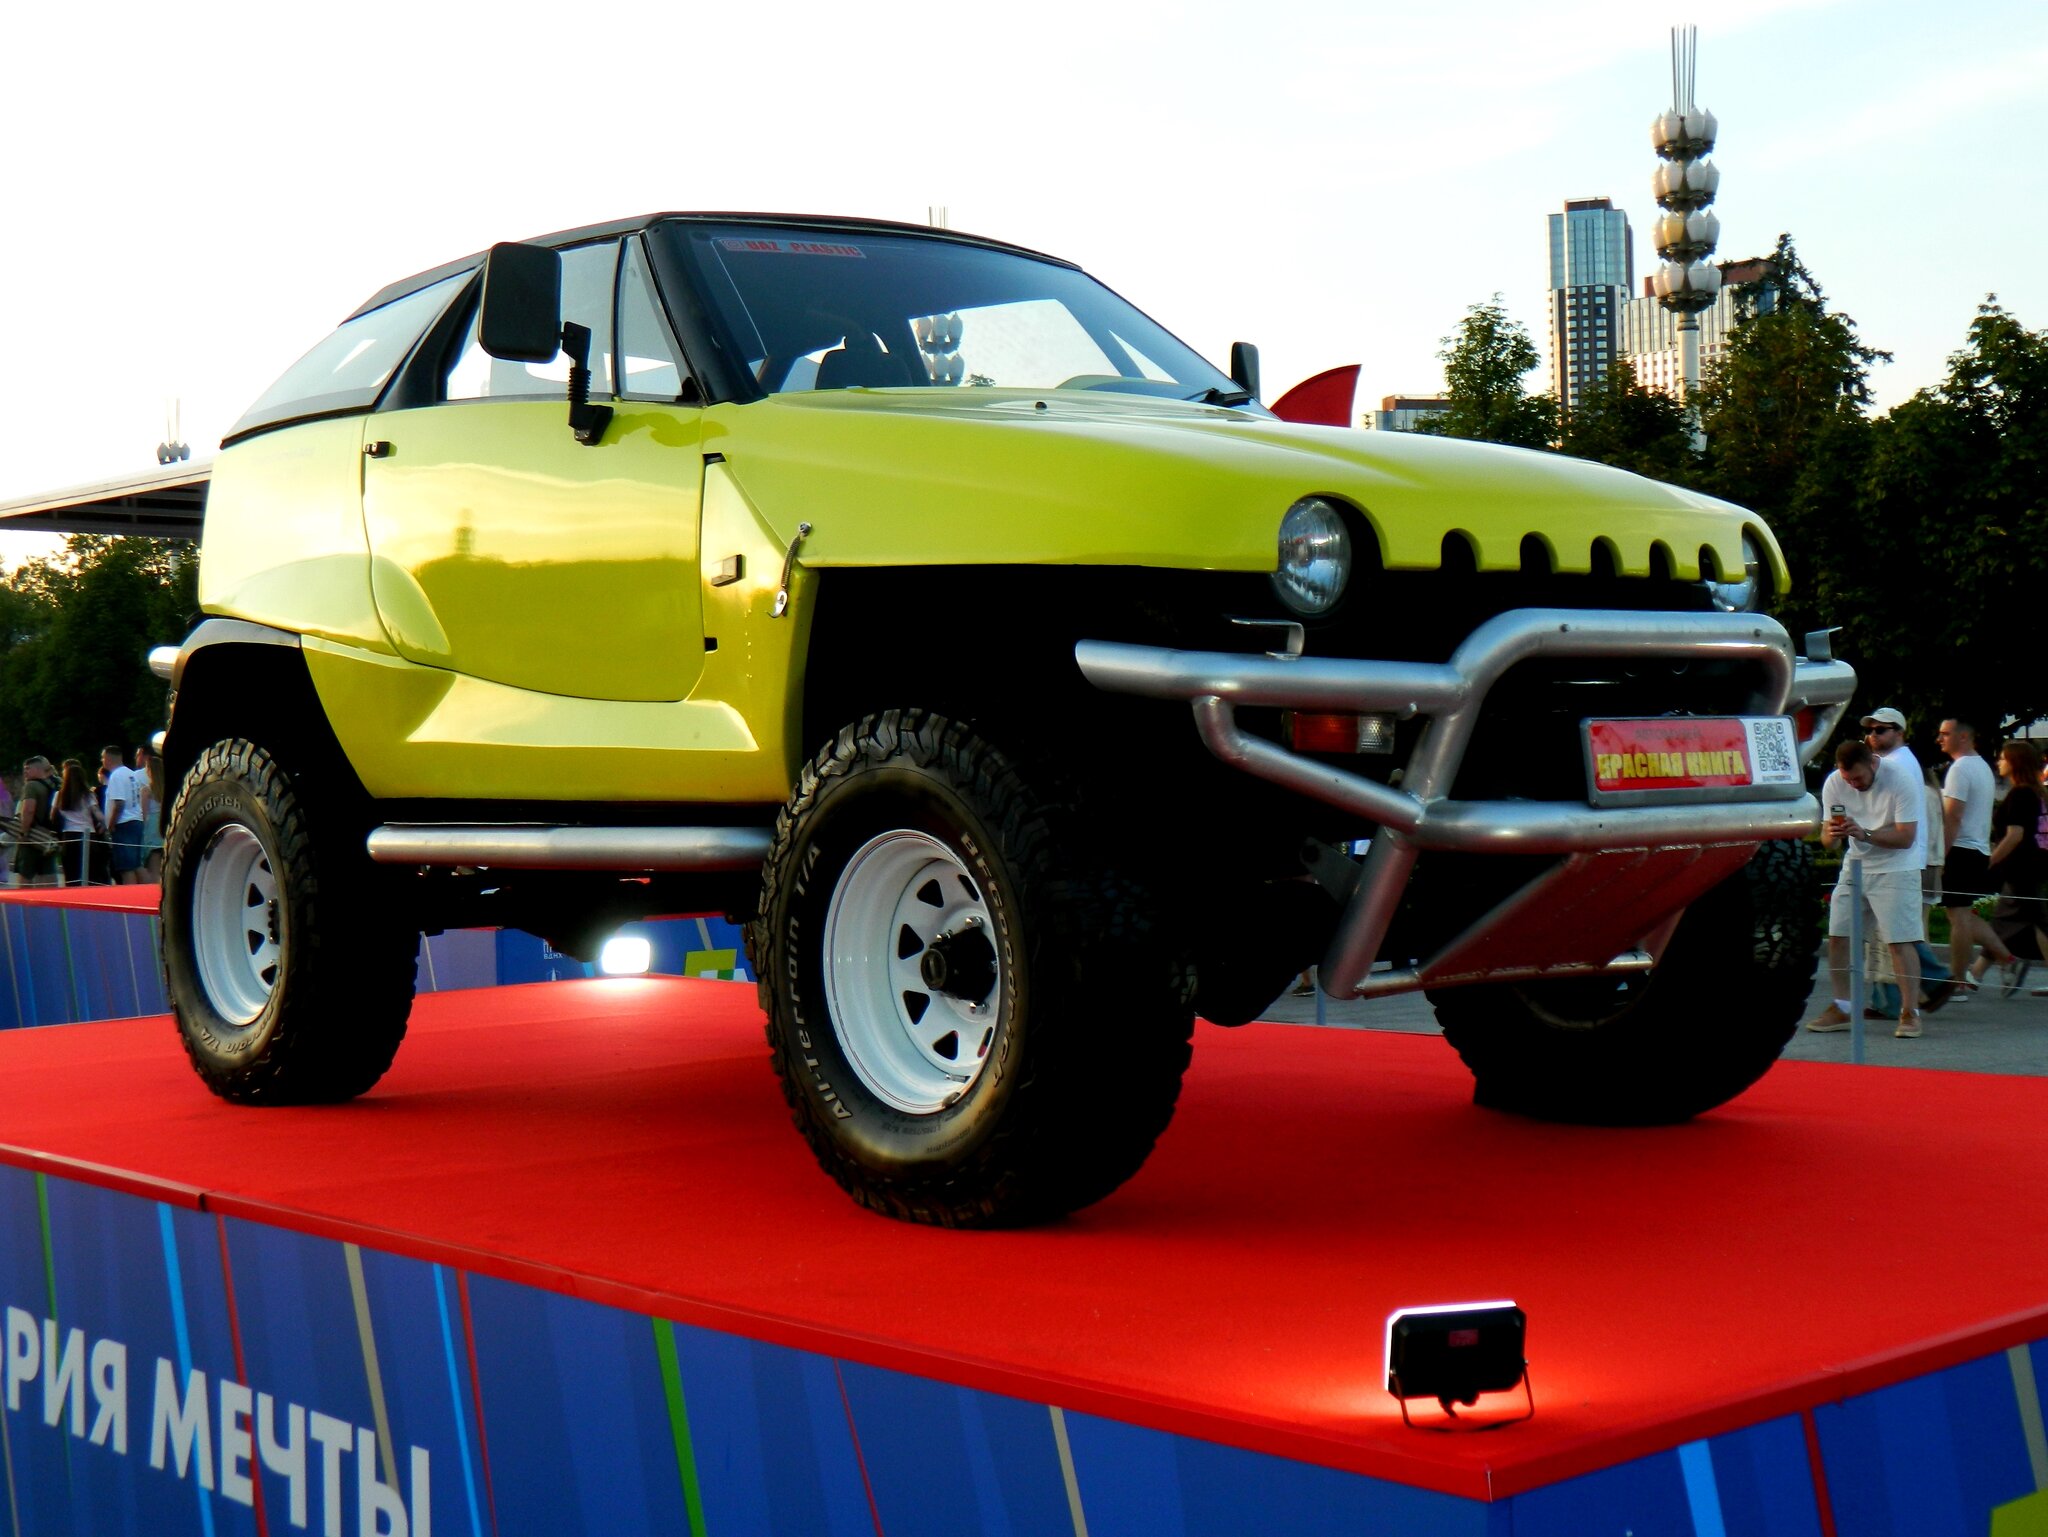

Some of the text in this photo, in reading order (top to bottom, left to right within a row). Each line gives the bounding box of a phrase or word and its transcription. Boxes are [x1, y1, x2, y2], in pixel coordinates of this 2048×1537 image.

[745, 240, 862, 257] UAZ PLASTIC
[1596, 750, 1746, 779] КРАСНАЯ КНИГА
[793, 841, 821, 896] T/A
[544, 952, 563, 960] ВДНХ
[961, 831, 1018, 1088] BFGoodrich
[0, 1305, 431, 1537] РИЯ МЕЧТЫ
